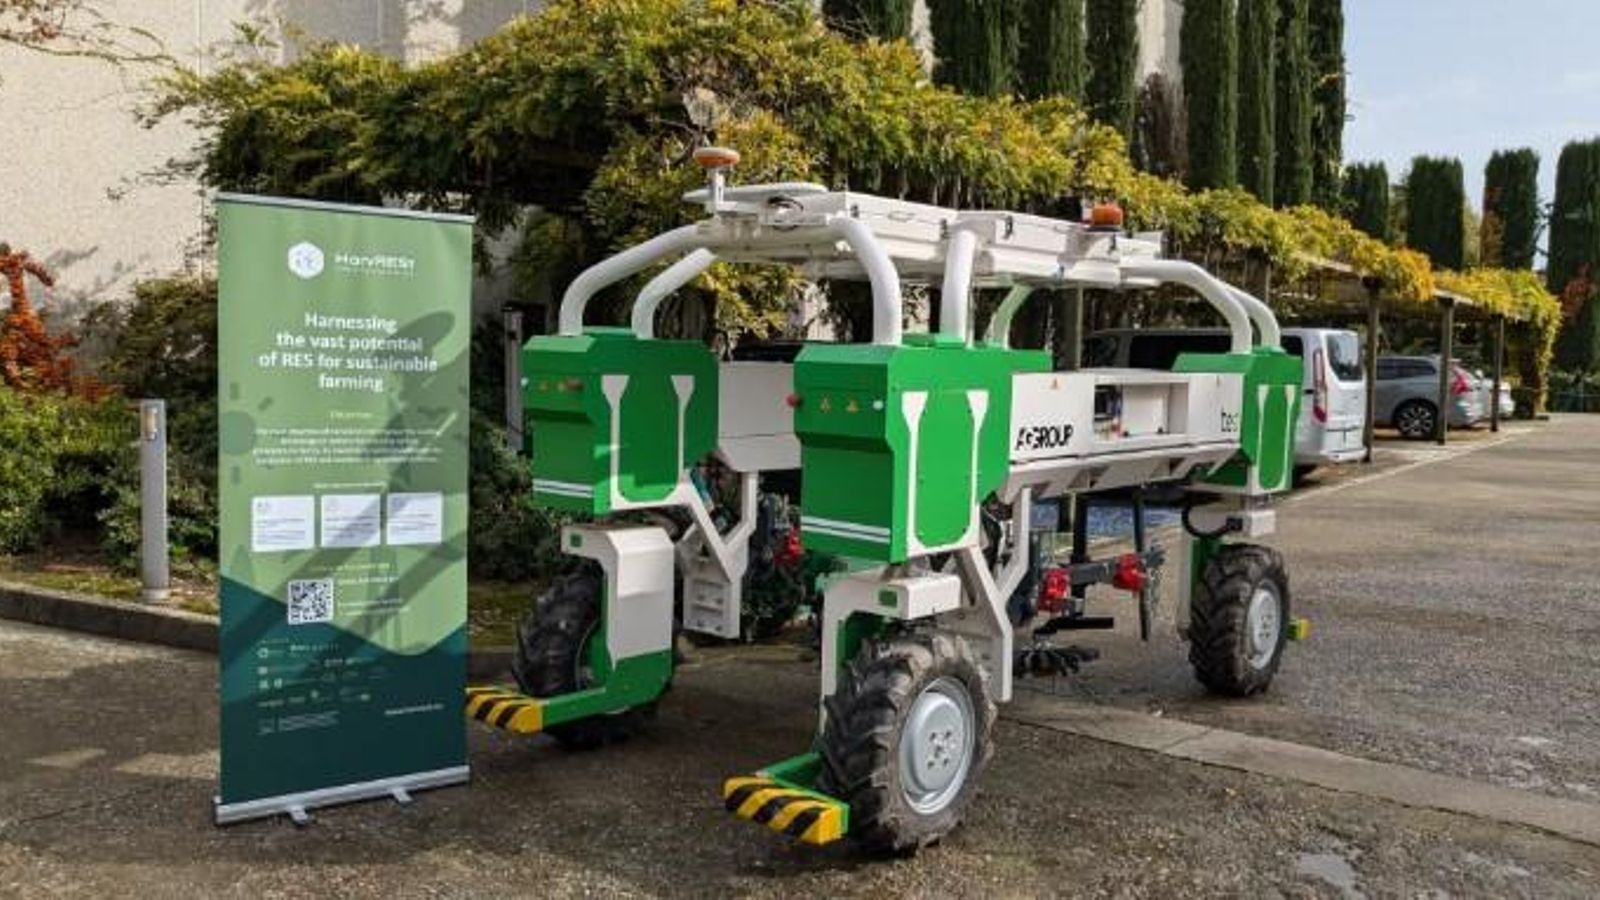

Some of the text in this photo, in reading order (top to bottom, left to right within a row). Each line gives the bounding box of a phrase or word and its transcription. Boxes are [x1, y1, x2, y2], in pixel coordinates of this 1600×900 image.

[304, 312, 398, 335] Harnessing
[276, 332, 424, 353] the vast potential
[259, 351, 438, 372] of RES for sustainable
[319, 373, 384, 393] farming
